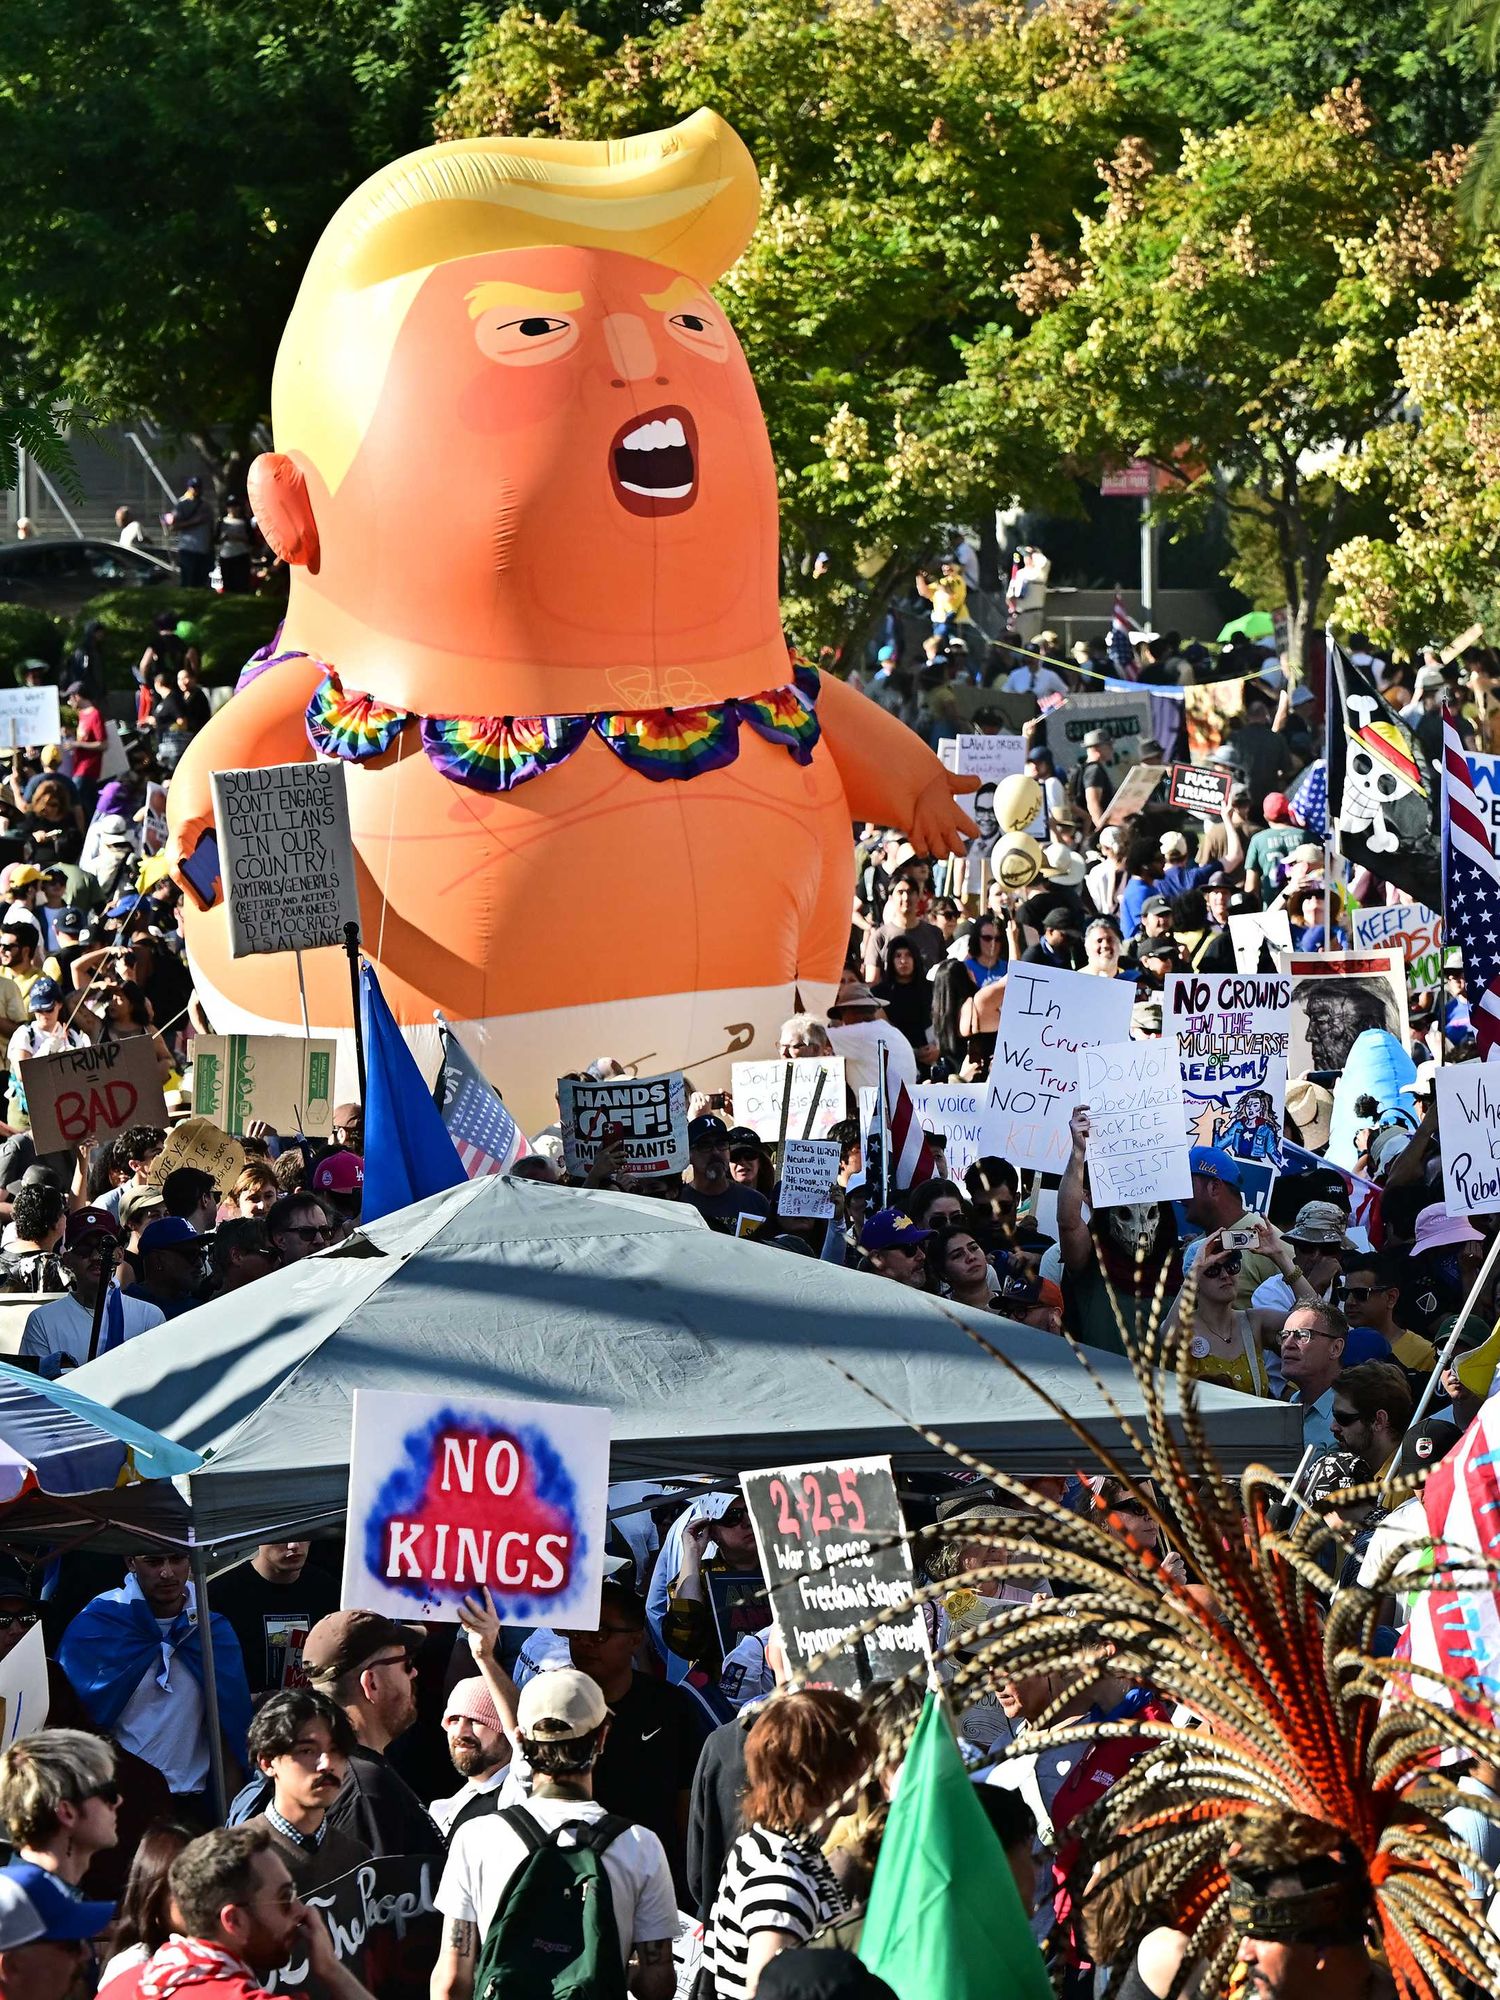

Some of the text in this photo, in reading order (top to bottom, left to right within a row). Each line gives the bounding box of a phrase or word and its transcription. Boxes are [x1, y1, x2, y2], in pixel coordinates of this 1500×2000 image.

[961, 737, 986, 750] LAW
[996, 740, 1023, 750] ORDER
[224, 763, 331, 794] SOLDIERS
[1176, 783, 1224, 804] TRUMP
[1184, 772, 1220, 790] FUCK
[226, 786, 335, 815] DON'T ENGAGE
[230, 806, 336, 836] CIVILIANS
[240, 828, 324, 858] IN OUR
[235, 848, 336, 880] COUNTRY!
[282, 895, 298, 906] AND
[301, 889, 336, 903] ACTIVE)
[238, 908, 258, 924] GET
[261, 908, 278, 920] OFF
[281, 904, 304, 920] YOUR
[244, 914, 340, 939] DEMOCRACY
[1356, 908, 1410, 947] KEEP
[247, 937, 272, 952] IS
[277, 933, 297, 950] AT
[1014, 974, 1062, 1020] In
[1173, 977, 1291, 1014] NO CROWNS
[1186, 1012, 1254, 1034] IN THE
[48, 1043, 121, 1074] TRUMP
[1004, 1041, 1036, 1072] We
[1176, 1032, 1288, 1058] MULTIVERSE
[1128, 1046, 1174, 1082] NOT
[1208, 1054, 1230, 1067] OF
[740, 1067, 768, 1090] Joy
[1036, 1068, 1078, 1092] Trus
[54, 1080, 138, 1141] BAD
[576, 1084, 666, 1108] HANDS
[937, 1094, 977, 1113] voice
[990, 1086, 1060, 1116] NOT
[578, 1104, 668, 1138] OFF!
[1129, 1112, 1168, 1132] ICE
[1005, 1120, 1073, 1160] KIN
[154, 1156, 177, 1186] VOTE
[786, 1165, 830, 1176] SIDED WITH
[786, 1175, 796, 1184] THE
[1092, 1150, 1176, 1199] RESIST
[441, 1437, 520, 1496] NO
[769, 1467, 866, 1540] 2+2=5
[386, 1521, 568, 1589] KINGS
[773, 1543, 804, 1570] War
[807, 1541, 822, 1570] is
[357, 1866, 437, 1940] Peopl
